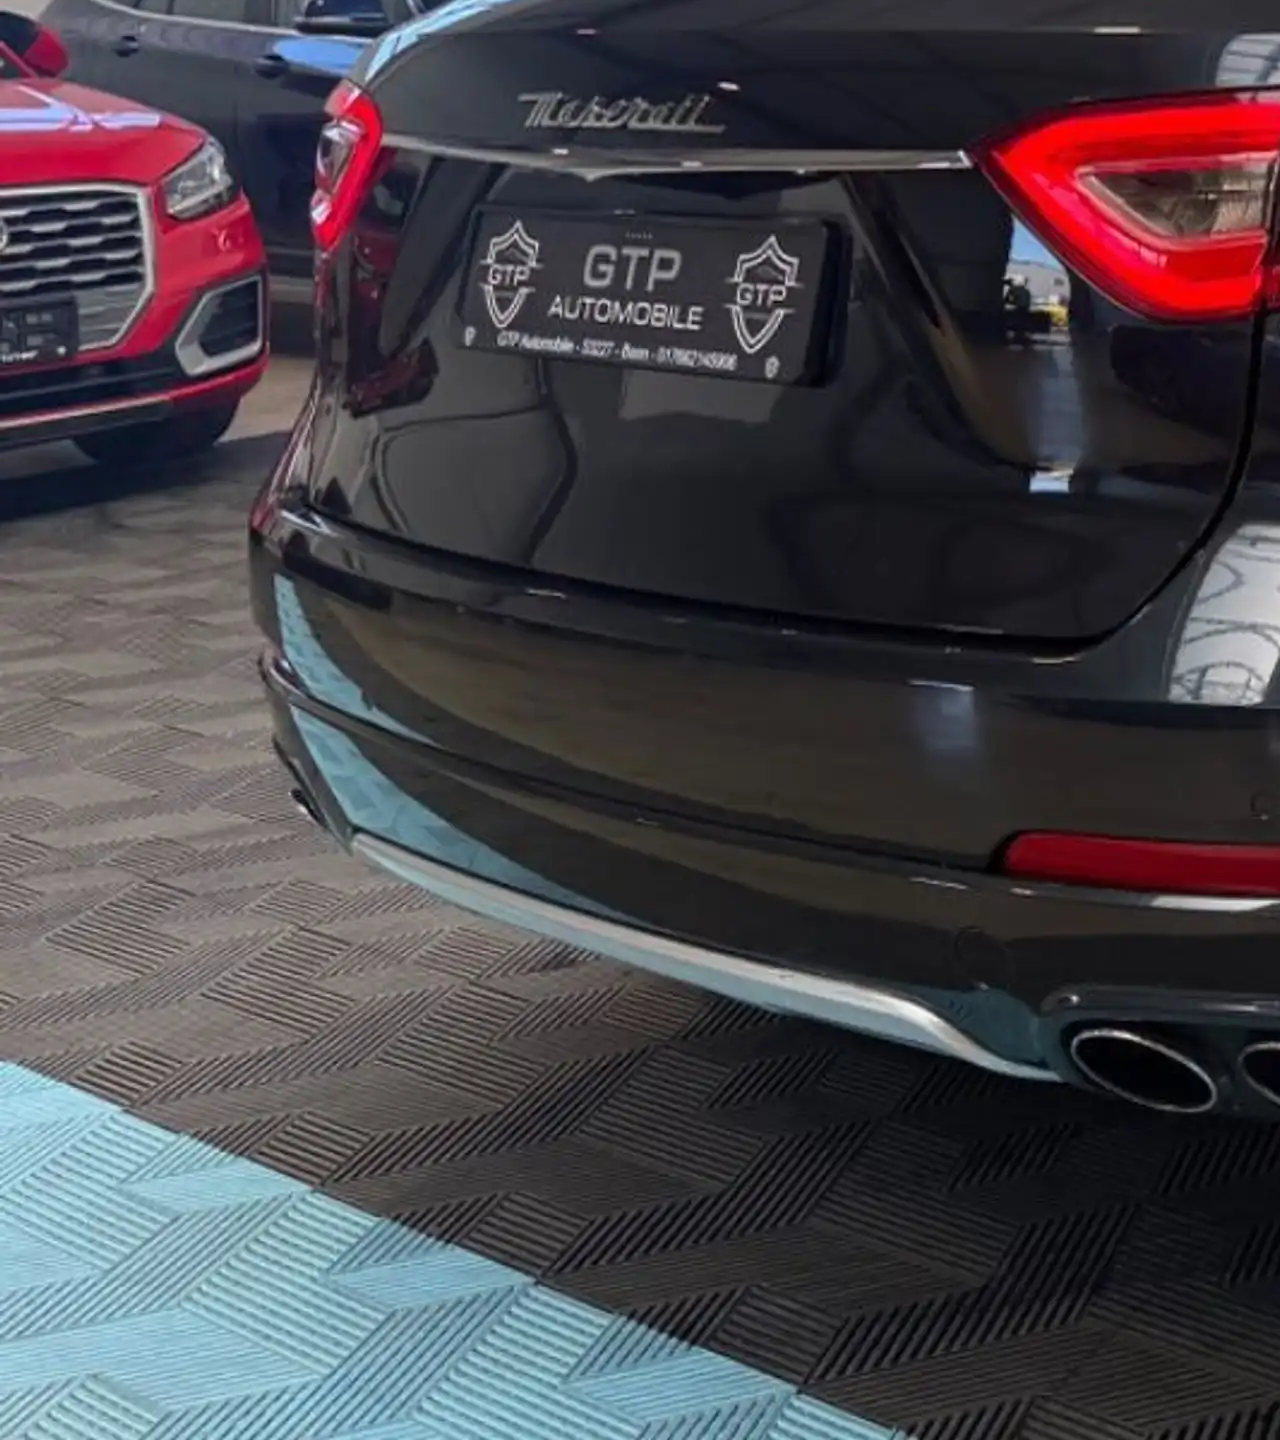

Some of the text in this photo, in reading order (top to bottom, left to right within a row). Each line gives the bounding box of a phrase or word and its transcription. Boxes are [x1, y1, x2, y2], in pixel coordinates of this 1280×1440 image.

[487, 264, 531, 286] GTP
[583, 244, 683, 292] GTP
[736, 282, 788, 309] GTP
[547, 294, 705, 331] AUTOMOBILE
